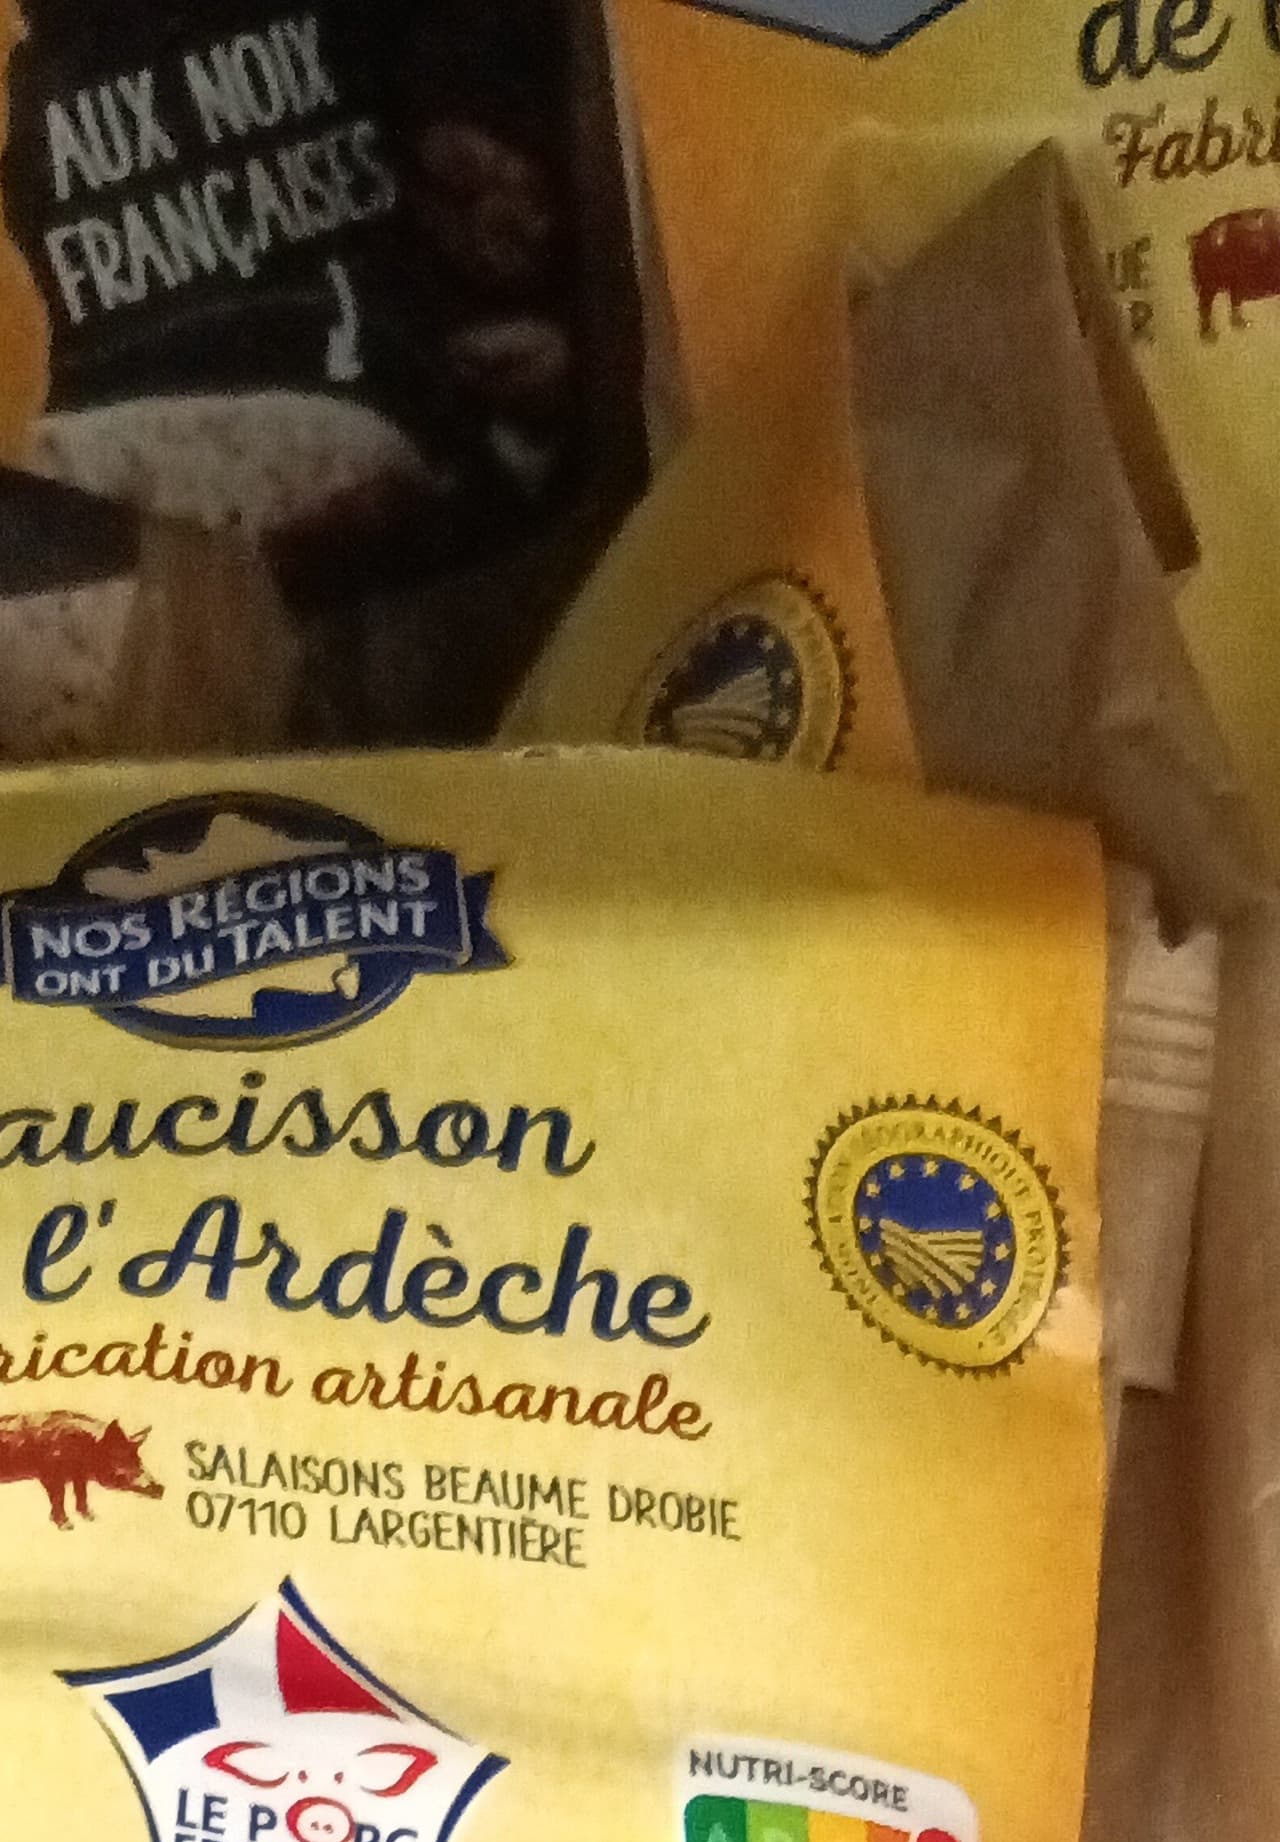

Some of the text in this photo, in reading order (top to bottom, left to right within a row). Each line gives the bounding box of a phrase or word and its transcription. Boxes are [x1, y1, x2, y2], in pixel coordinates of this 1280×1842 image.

[47, 15, 338, 200] AUX NOIX
[31, 913, 152, 959] NOS
[35, 901, 438, 996] ONT DU TALENT
[22, 1195, 712, 1350] l'Ardèche
[310, 1372, 714, 1441] artisanale
[185, 1439, 741, 1542] SALAISONS BEAUME DROBIE
[187, 1492, 306, 1540] 07110
[176, 1786, 228, 1834] LE
[689, 1748, 911, 1812] NUTRI-SCORE
